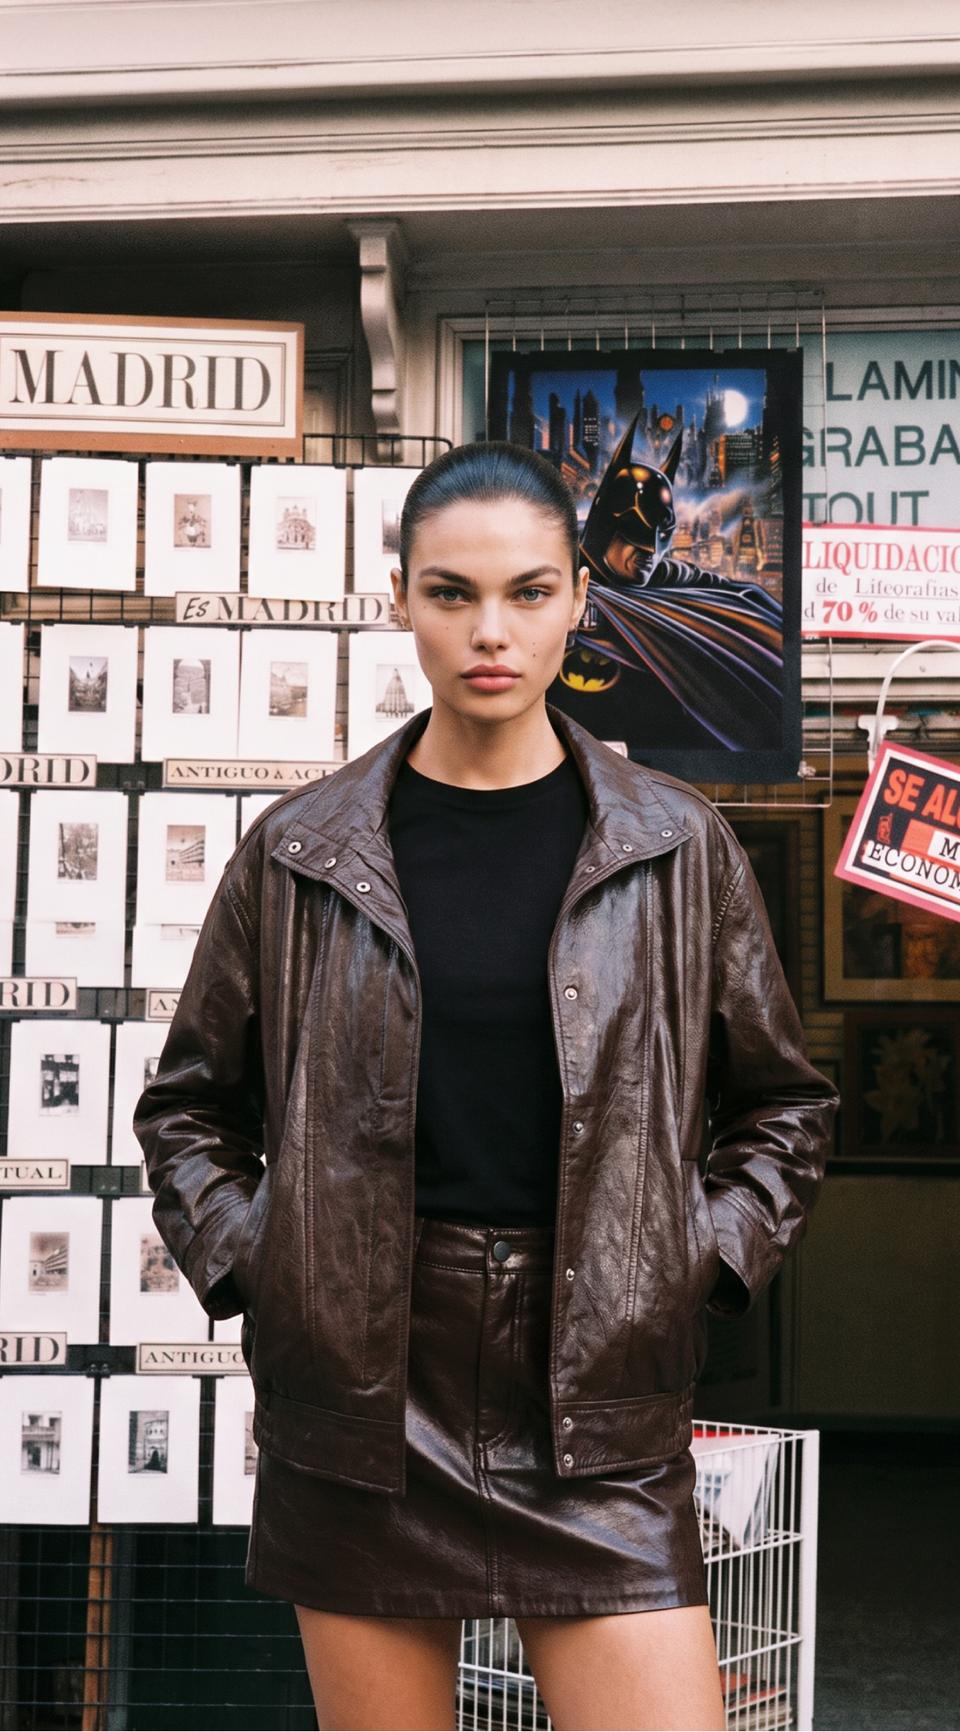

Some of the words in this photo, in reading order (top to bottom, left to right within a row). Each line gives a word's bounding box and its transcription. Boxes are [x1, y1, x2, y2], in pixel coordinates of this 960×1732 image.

[9, 348, 271, 411] MADRID
[816, 577, 838, 594] de
[182, 597, 210, 621] Es
[216, 596, 383, 621] MADRID
[822, 600, 853, 624] 70
[859, 601, 878, 624] %
[884, 603, 905, 620] de
[910, 608, 929, 621] su
[171, 766, 270, 780] ANTIGUO
[883, 768, 926, 812] SE
[920, 783, 960, 828] AL
[0, 1167, 62, 1179] TUAL
[145, 1351, 246, 1364] ANTIGUO
